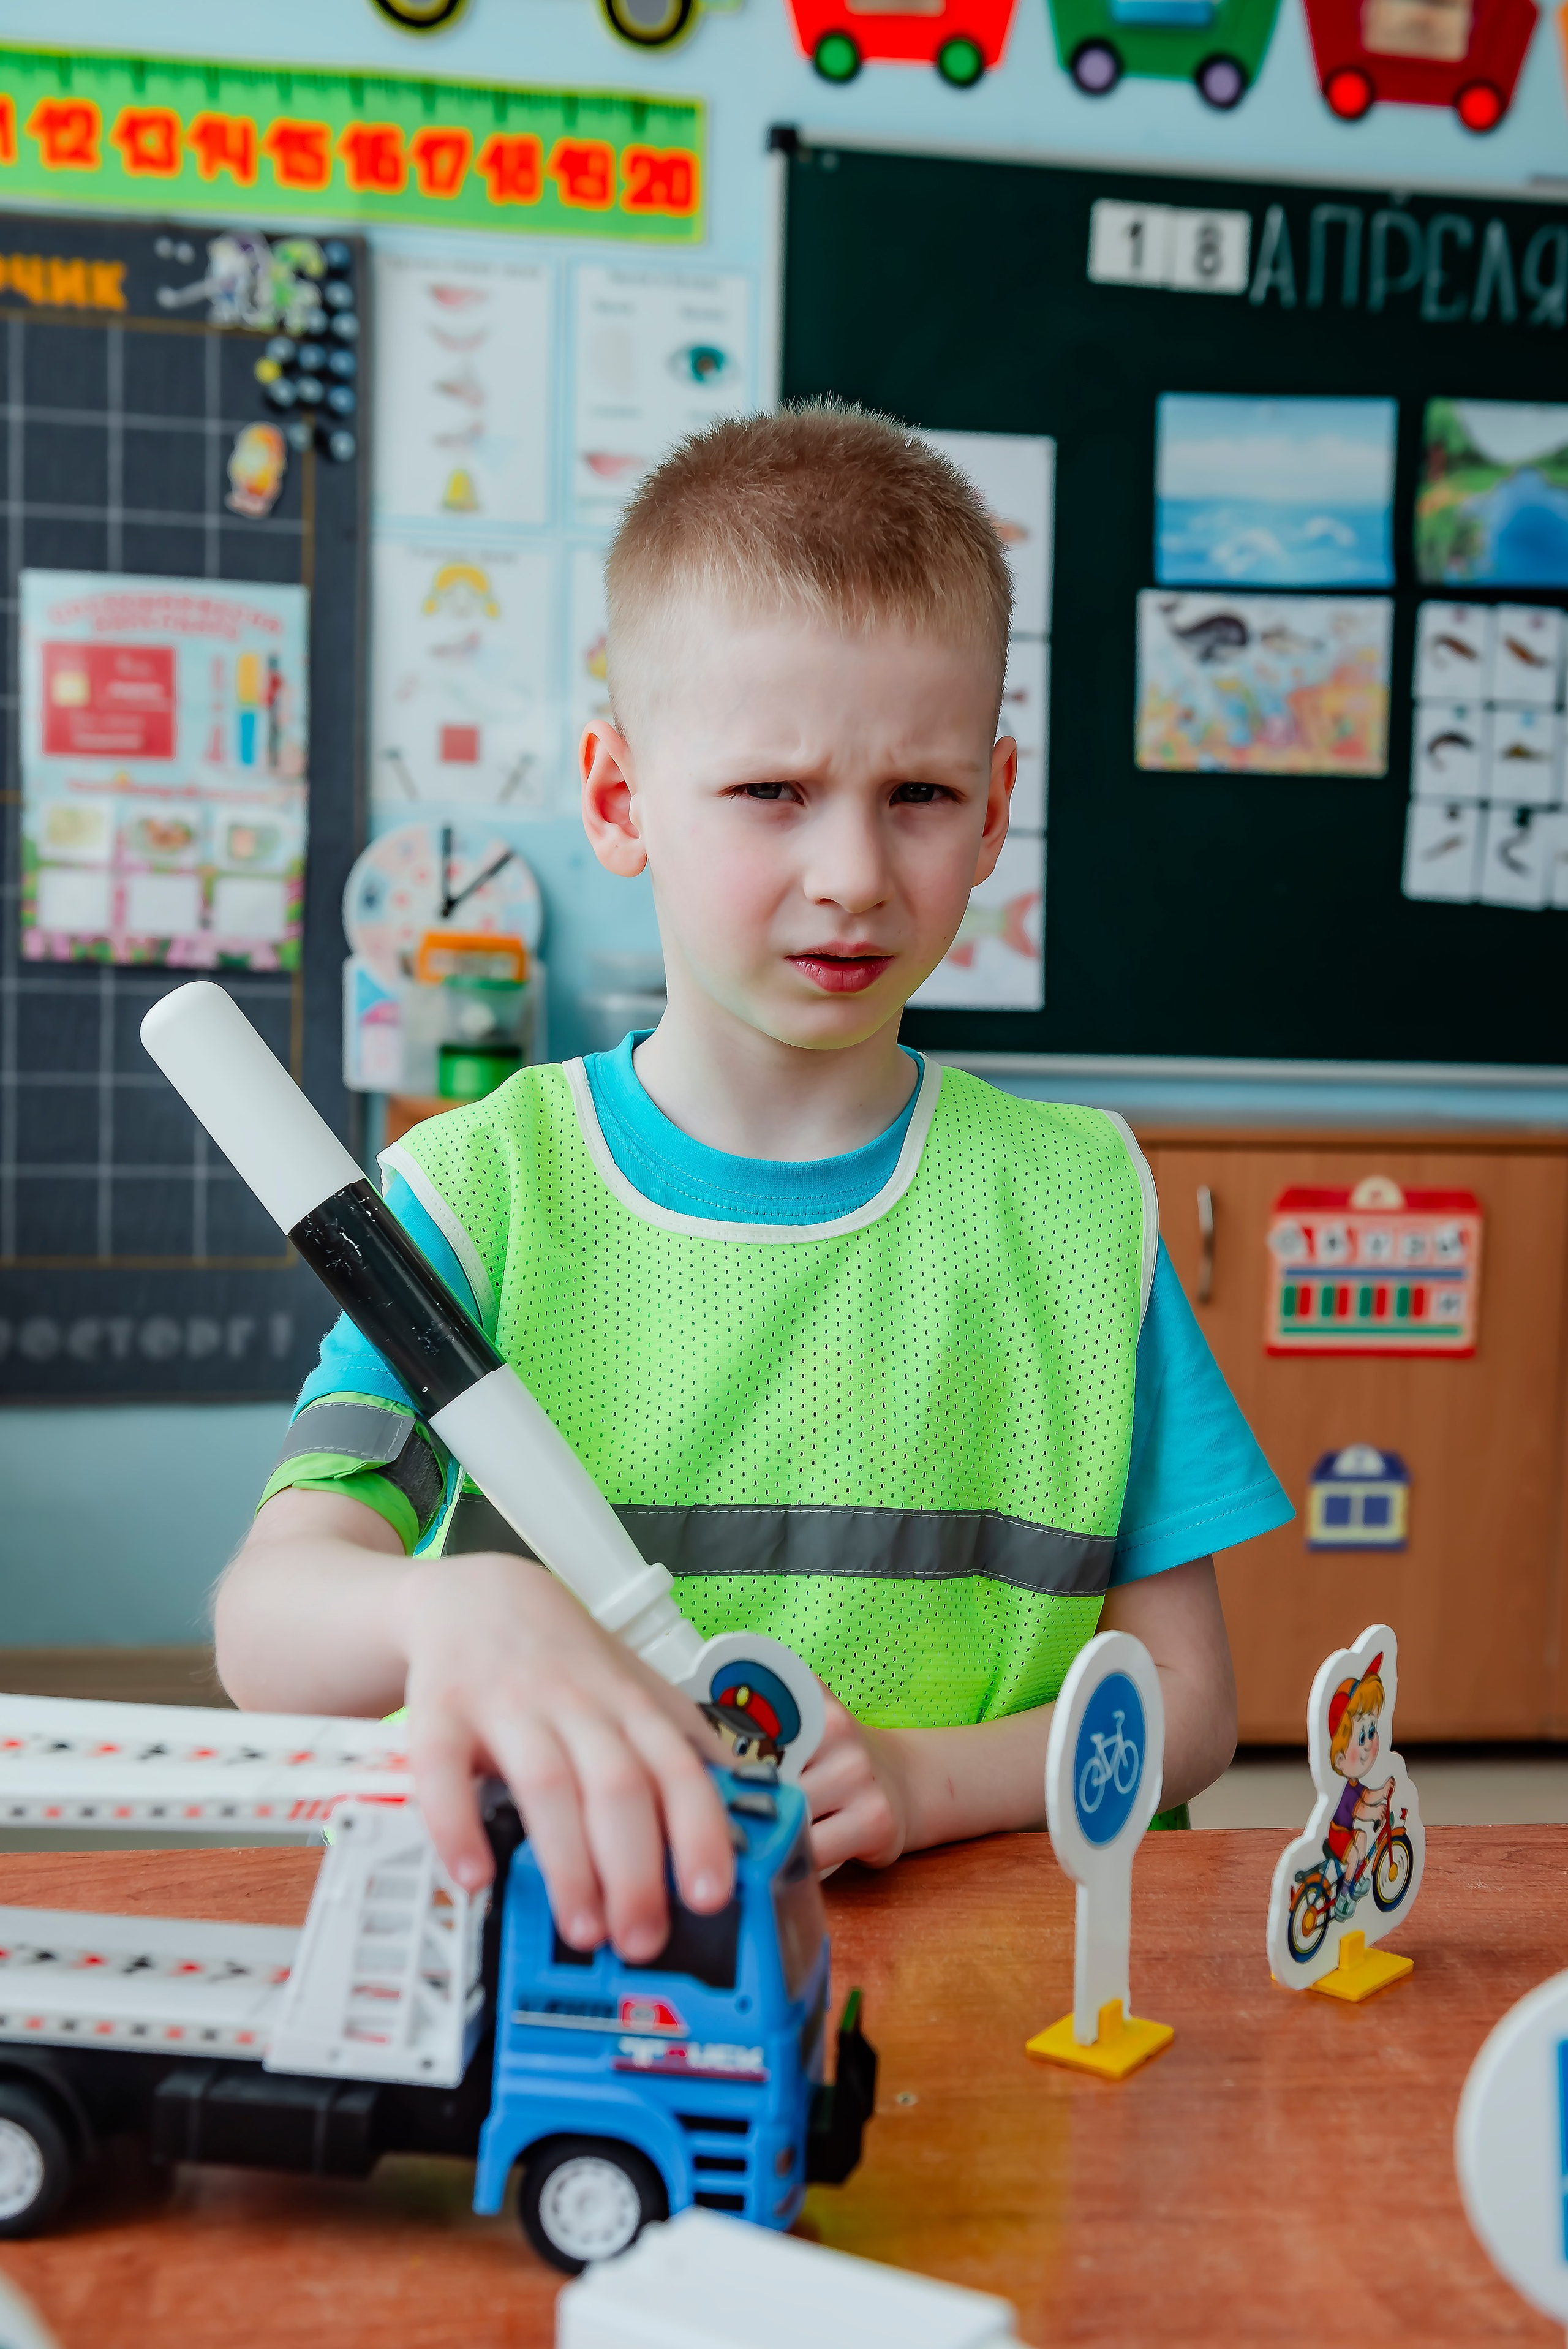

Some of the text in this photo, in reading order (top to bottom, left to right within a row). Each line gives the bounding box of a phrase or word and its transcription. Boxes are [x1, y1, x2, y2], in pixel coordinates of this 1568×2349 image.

[27, 99, 100, 169] 12
[111, 108, 181, 177] 13
[186, 113, 257, 185] 14
[263, 119, 331, 189] 15
[337, 123, 406, 193] 16
[410, 127, 472, 197] 17
[476, 134, 543, 203] 18
[547, 139, 614, 209] 19
[621, 146, 699, 216] 20
[1248, 202, 1568, 330] АПРЕЛЯ
